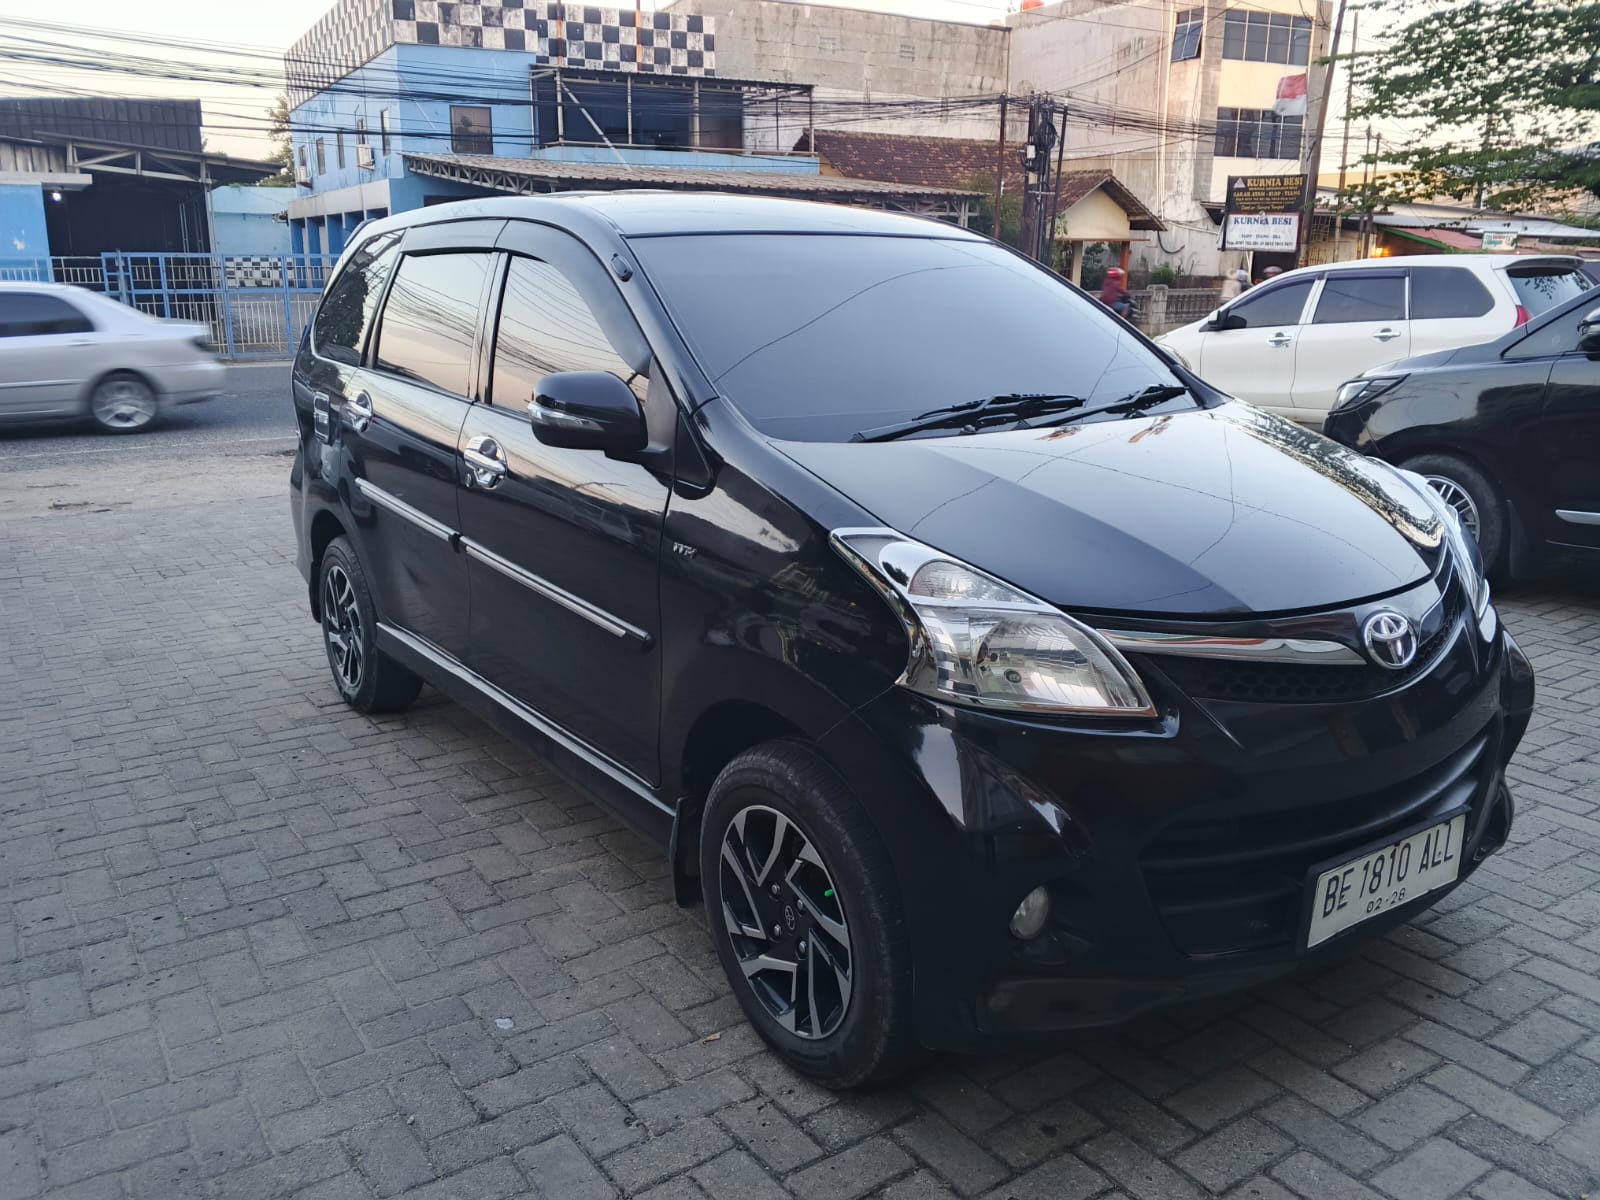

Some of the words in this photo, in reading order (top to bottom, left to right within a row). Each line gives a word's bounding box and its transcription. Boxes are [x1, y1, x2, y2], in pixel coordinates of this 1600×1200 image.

[1247, 178, 1281, 187] KURNIA
[1284, 177, 1303, 186] BESI
[1233, 217, 1269, 225] KURNIA
[1272, 217, 1292, 225] BESI
[1322, 867, 1354, 918] BE
[1359, 843, 1411, 899] 1810
[1418, 823, 1454, 874] ALL
